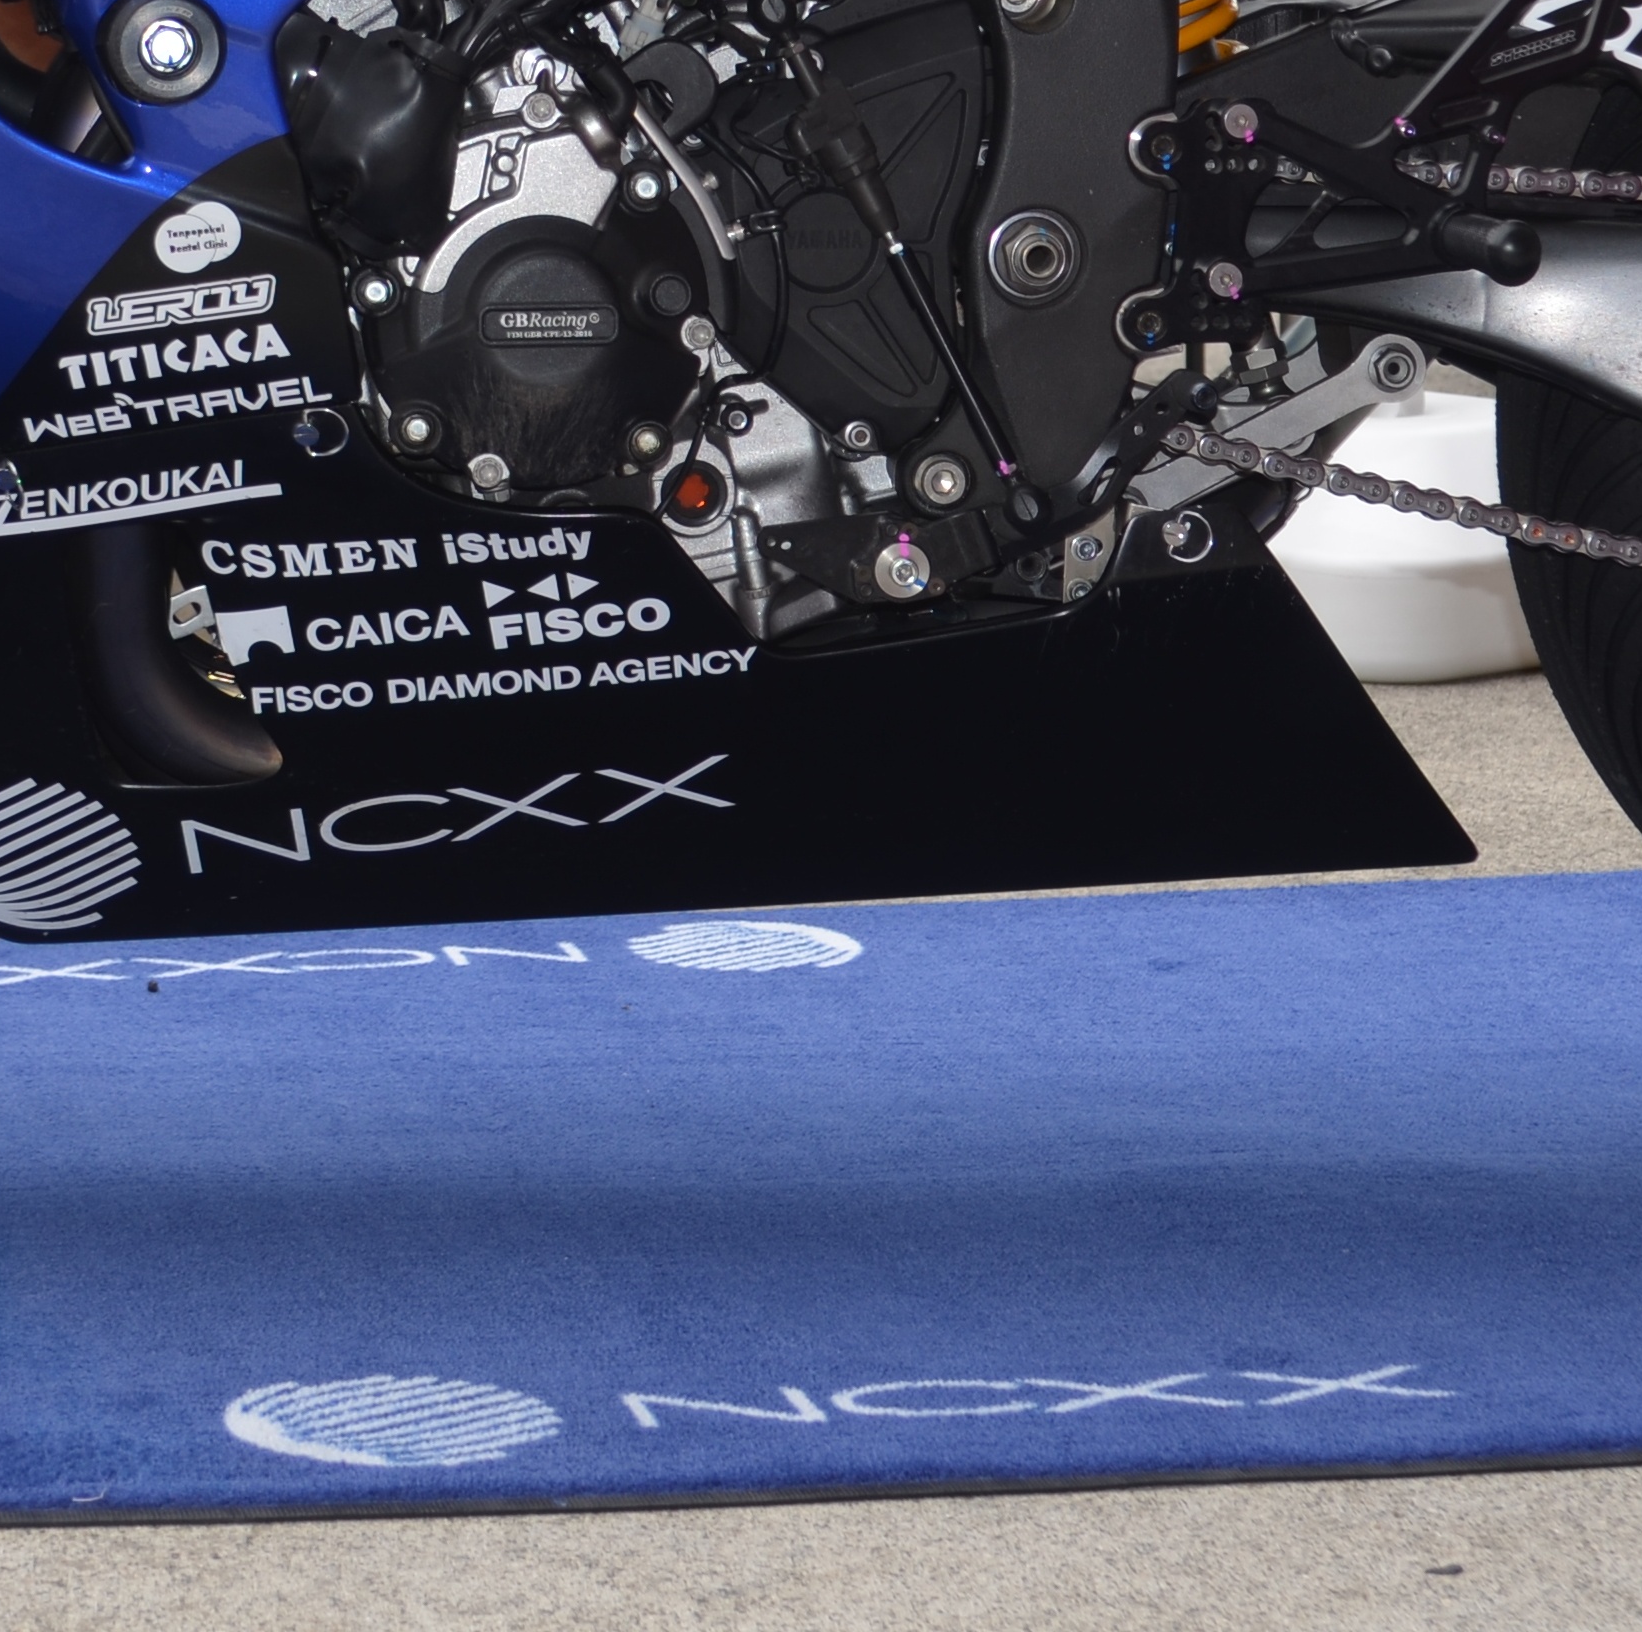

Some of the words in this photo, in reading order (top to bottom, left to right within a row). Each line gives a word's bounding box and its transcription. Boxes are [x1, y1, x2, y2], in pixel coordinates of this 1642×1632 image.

[1490, 29, 1577, 67] STRIKER
[169, 241, 201, 254] Dental
[787, 228, 864, 255] YAMAHA
[88, 275, 276, 336] LEROY
[59, 323, 292, 390] TITICACA
[201, 538, 418, 579] CSMEN
[442, 527, 593, 565] iStudy
[305, 605, 471, 652] CAICA
[488, 597, 672, 651] FISCO
[250, 679, 374, 715] FISCO
[386, 664, 582, 705] DIAMOND
[588, 645, 758, 689] AGENCY
[180, 754, 737, 875] NCXX
[621, 1364, 1453, 1432] NCXX
